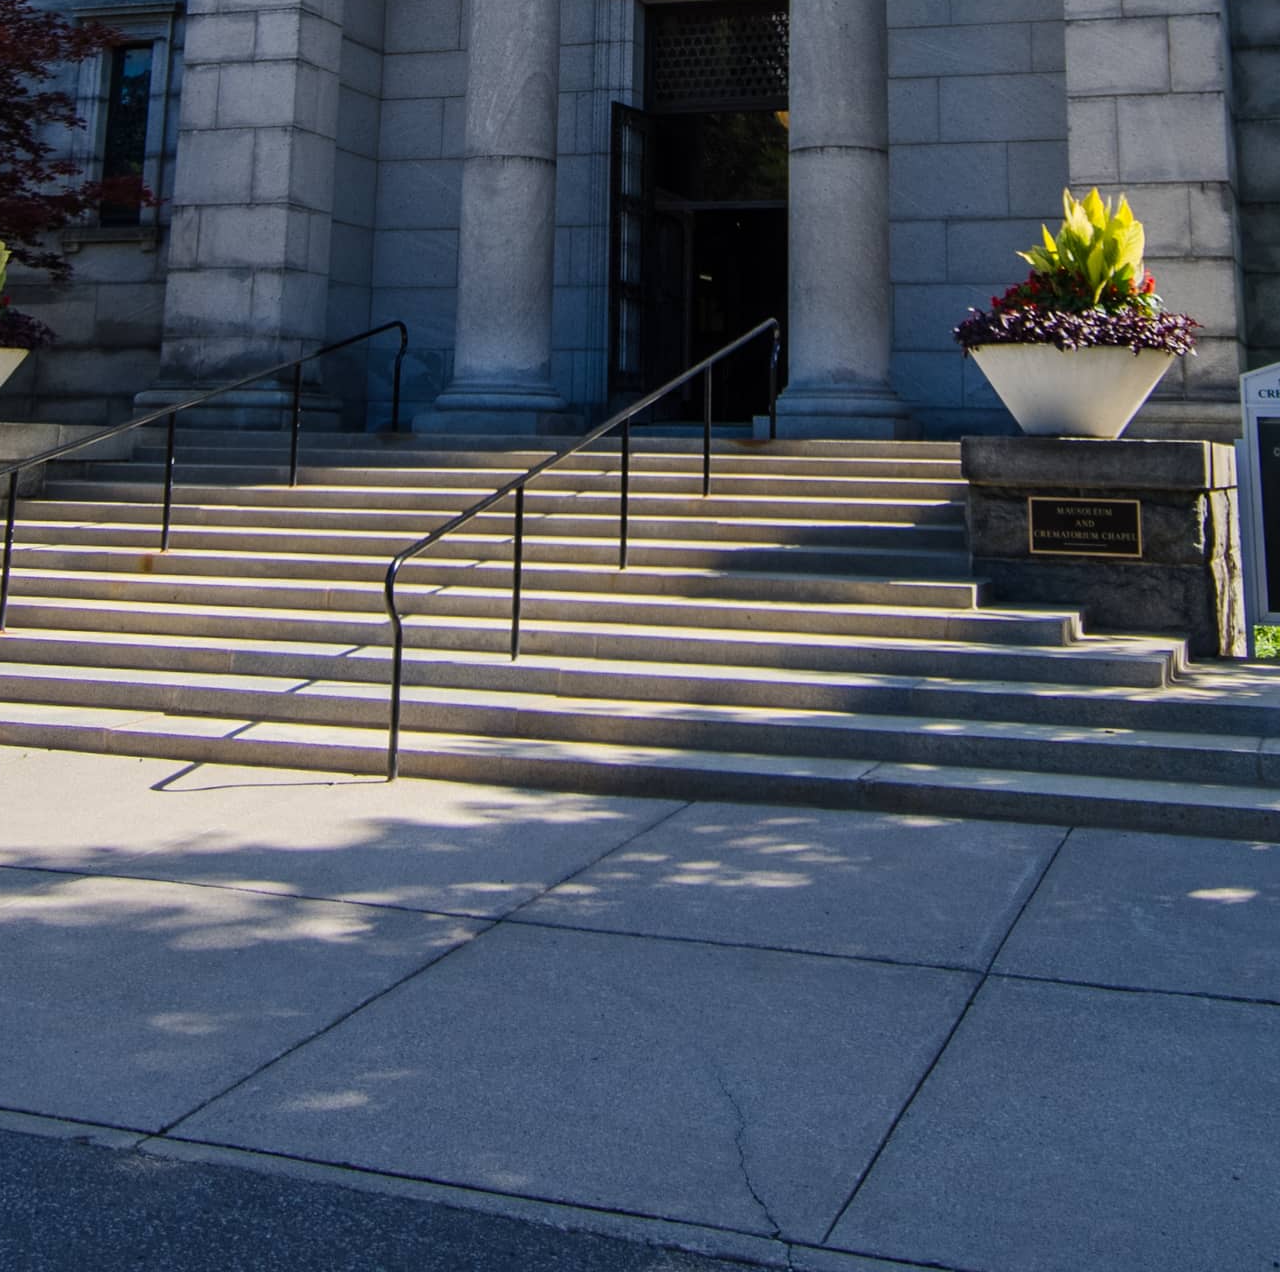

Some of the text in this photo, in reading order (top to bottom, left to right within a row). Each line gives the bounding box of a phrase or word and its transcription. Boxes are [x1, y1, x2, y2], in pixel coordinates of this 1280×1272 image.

[1056, 506, 1113, 516] MAUSOLEUM
[1075, 519, 1096, 528] AND
[1034, 530, 1137, 541] CREMATORIUM CHAPEL
